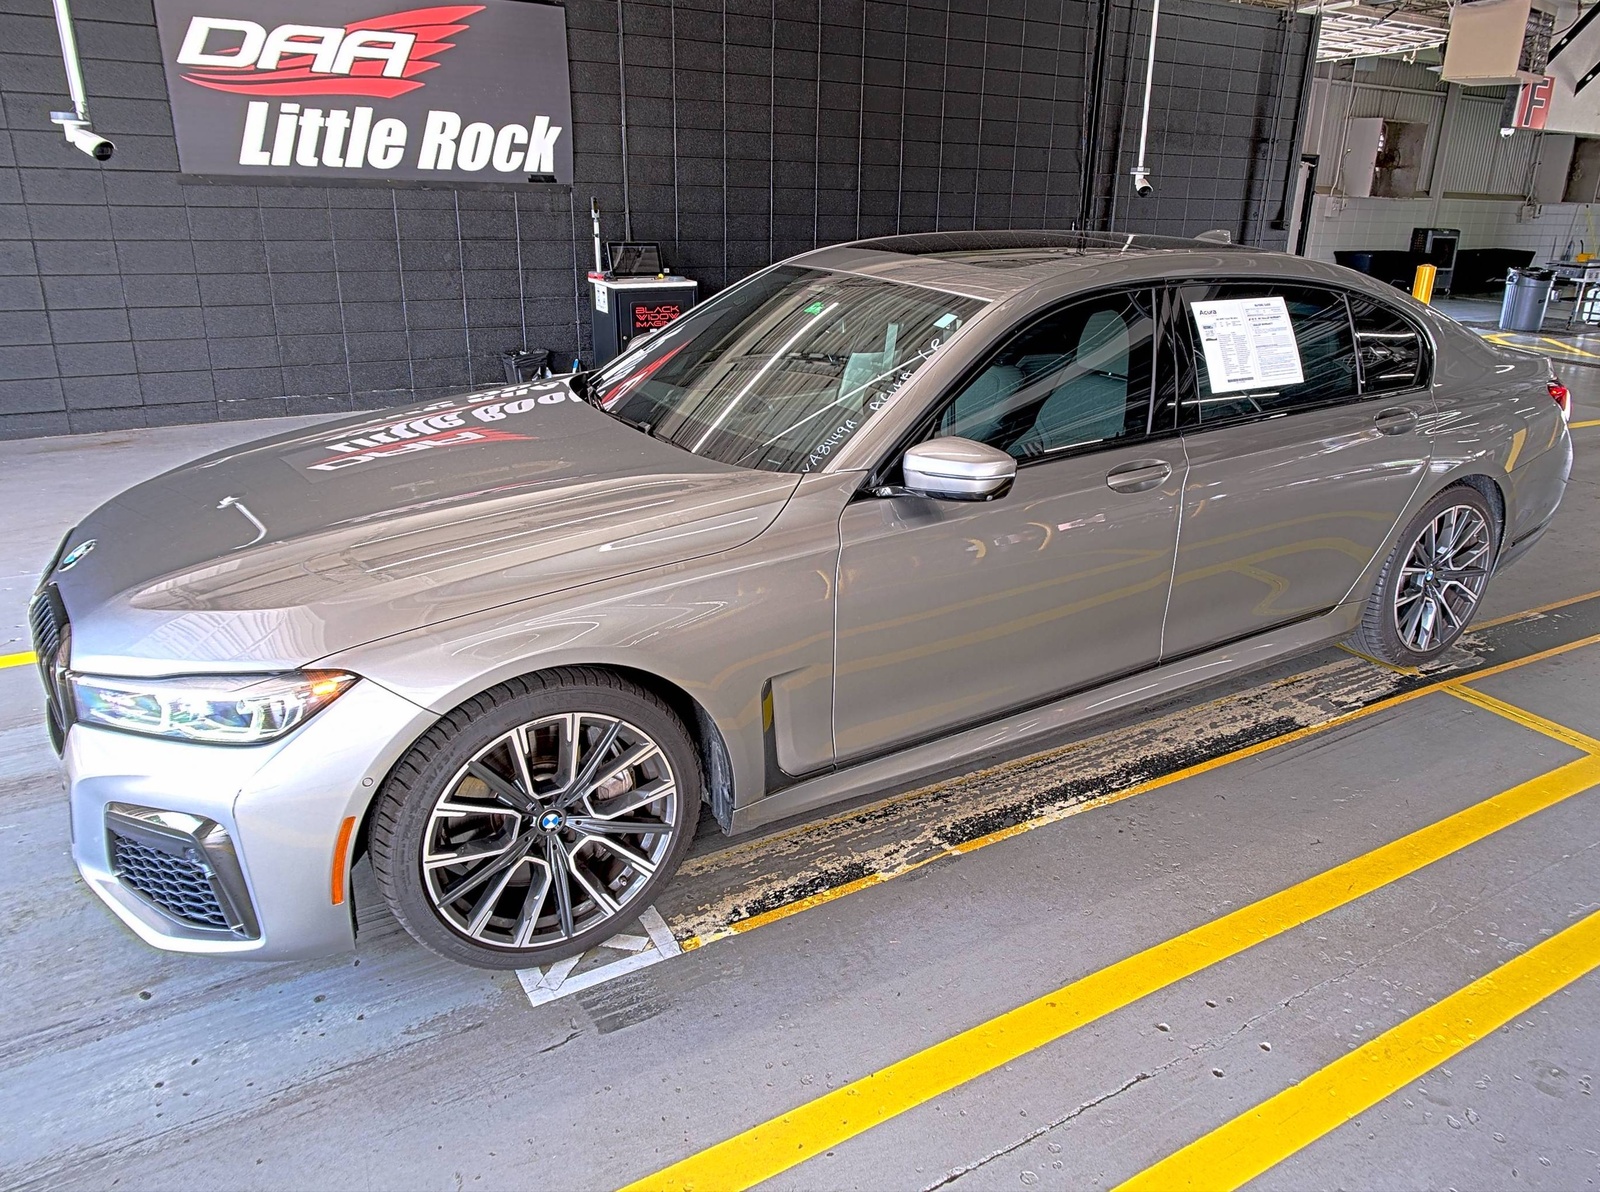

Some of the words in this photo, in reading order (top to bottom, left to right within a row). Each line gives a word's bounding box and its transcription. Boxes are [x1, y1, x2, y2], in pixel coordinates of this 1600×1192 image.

[177, 16, 416, 78] DAA
[1522, 77, 1551, 127] F
[239, 101, 409, 170] Little
[417, 110, 562, 174] Rock
[635, 305, 680, 314] BLACK
[635, 312, 680, 321] WIDOW
[635, 320, 670, 328] IMAGIN
